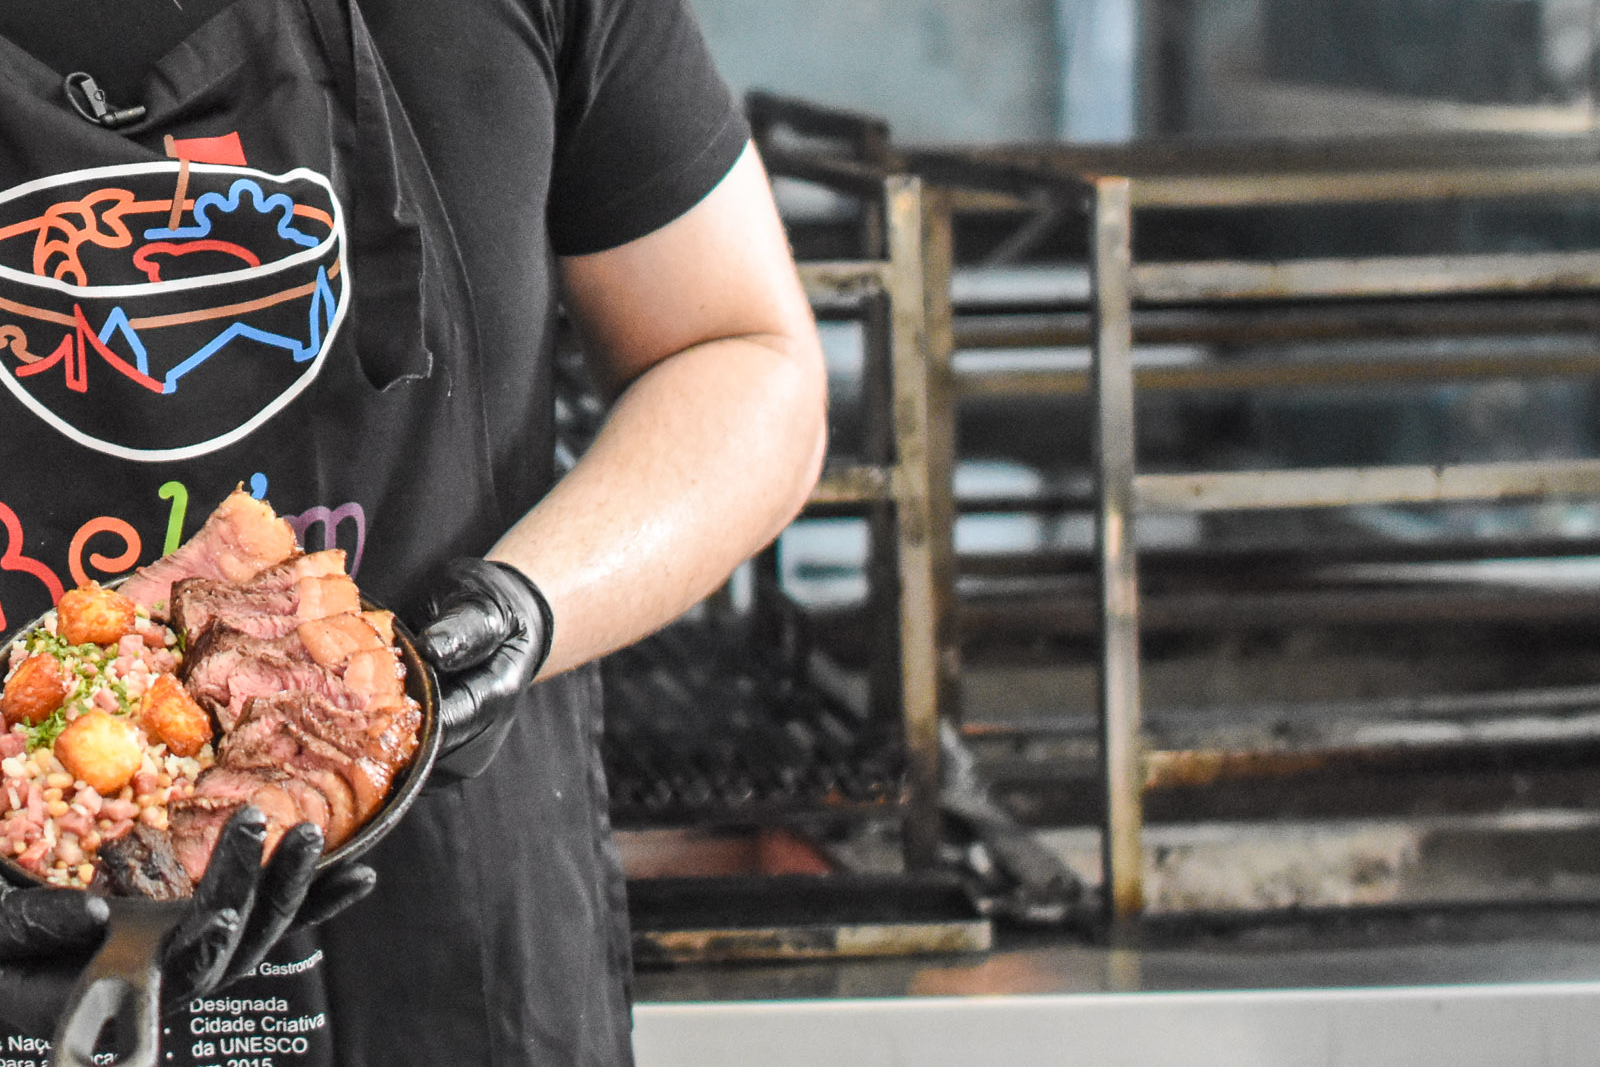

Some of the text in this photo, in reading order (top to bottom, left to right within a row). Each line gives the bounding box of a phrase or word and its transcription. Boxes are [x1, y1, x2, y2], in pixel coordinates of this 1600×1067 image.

[190, 996, 288, 1015] Designada
[190, 1012, 325, 1035] Cidade Criativa
[191, 1036, 308, 1058] da UNESCO
